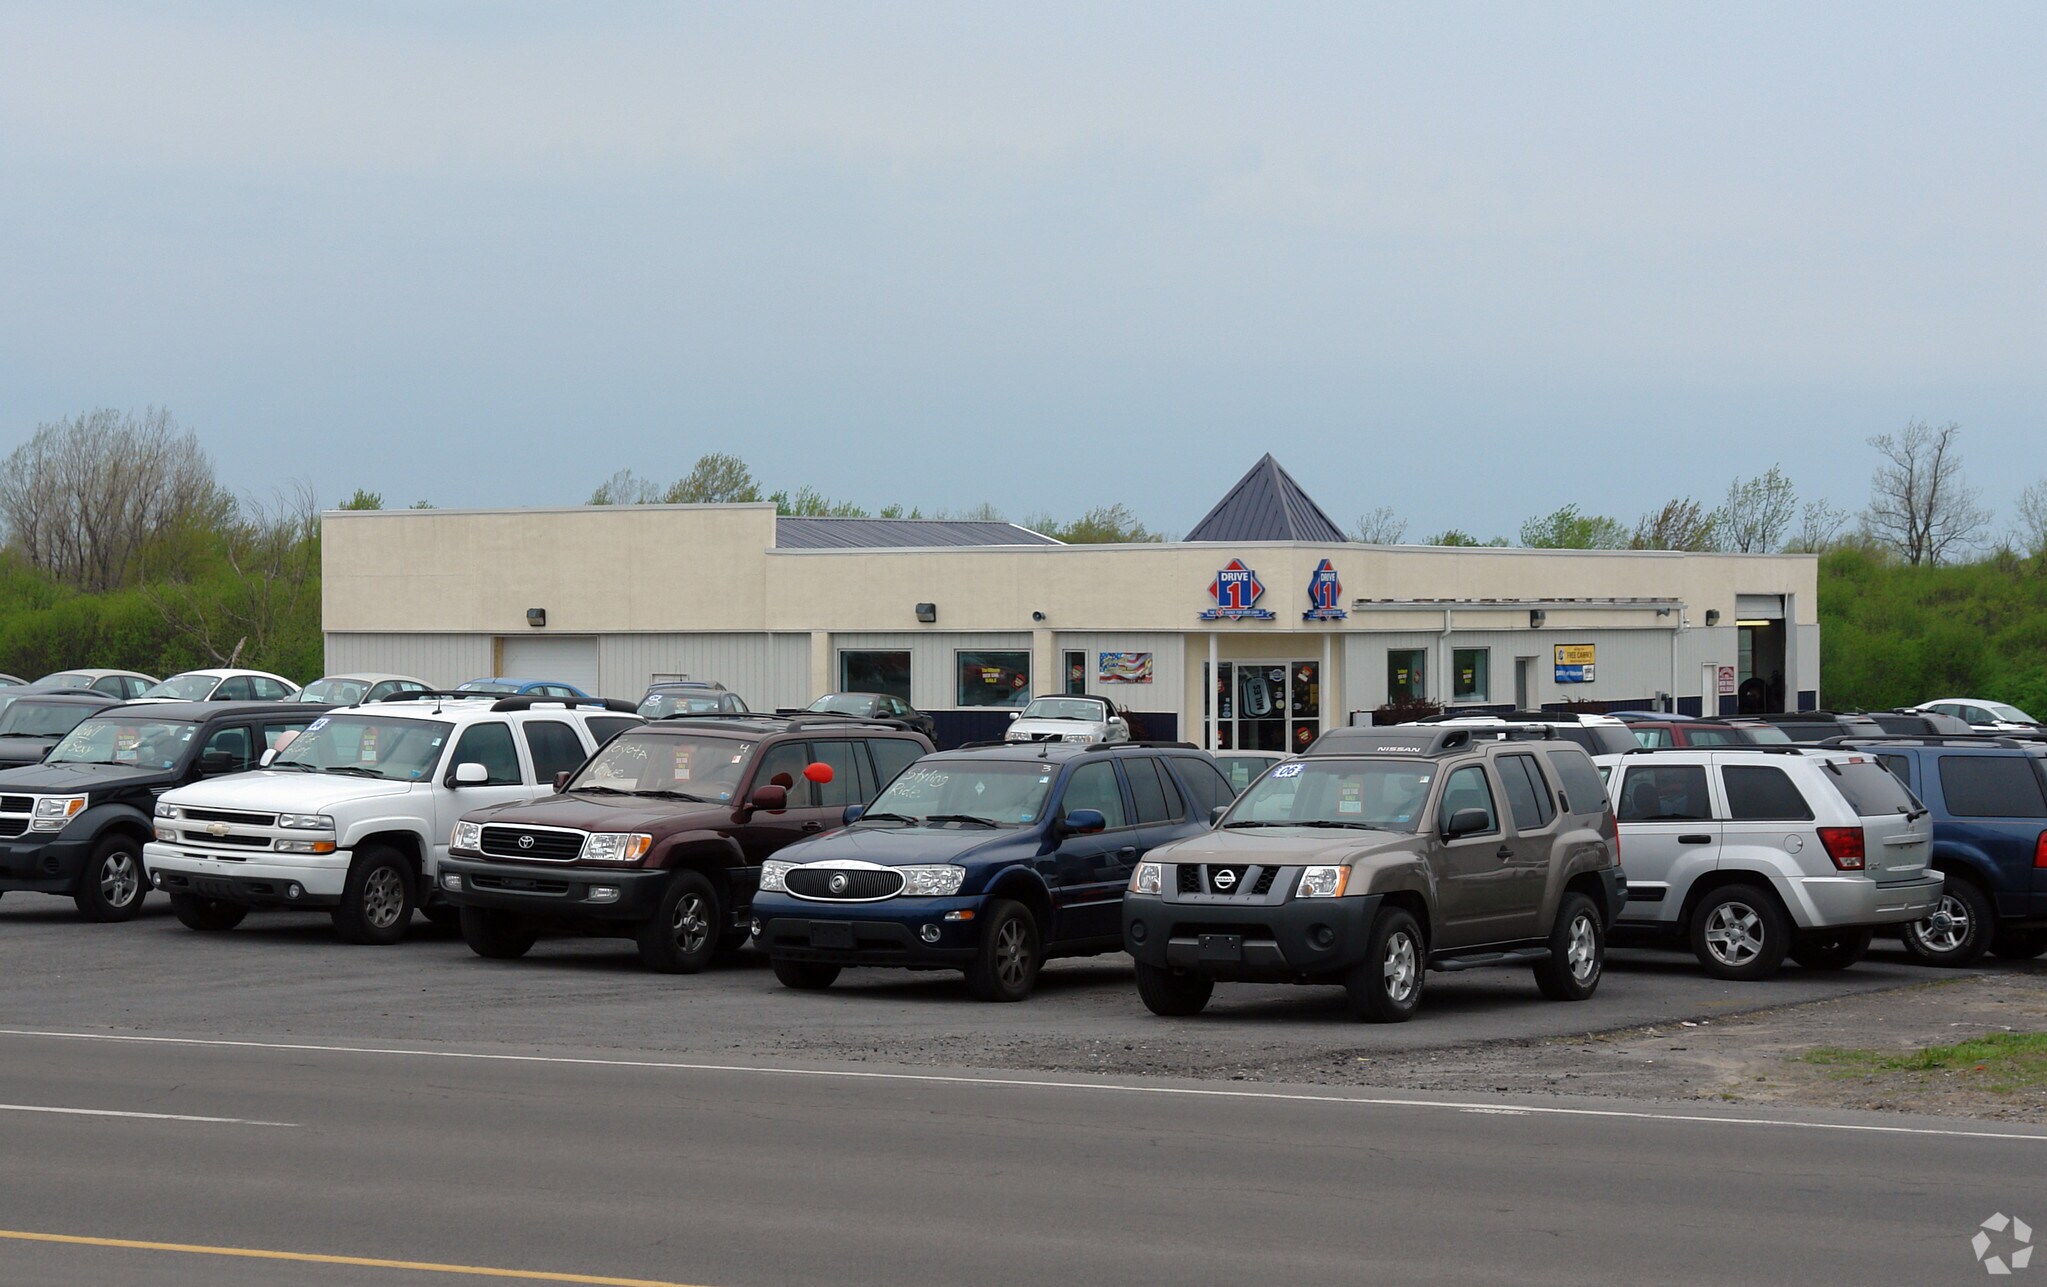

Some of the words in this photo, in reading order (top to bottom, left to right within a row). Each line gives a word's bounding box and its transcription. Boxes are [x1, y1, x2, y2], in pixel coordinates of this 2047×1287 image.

[1221, 572, 1249, 581] DRIVE
[1320, 572, 1336, 582] DRIVE
[1226, 581, 1242, 609] 1
[1323, 581, 1333, 609] 1
[1253, 685, 1265, 710] MILES
[739, 743, 750, 753] 4
[1041, 764, 1052, 773] 3
[1279, 765, 1298, 775] 06
